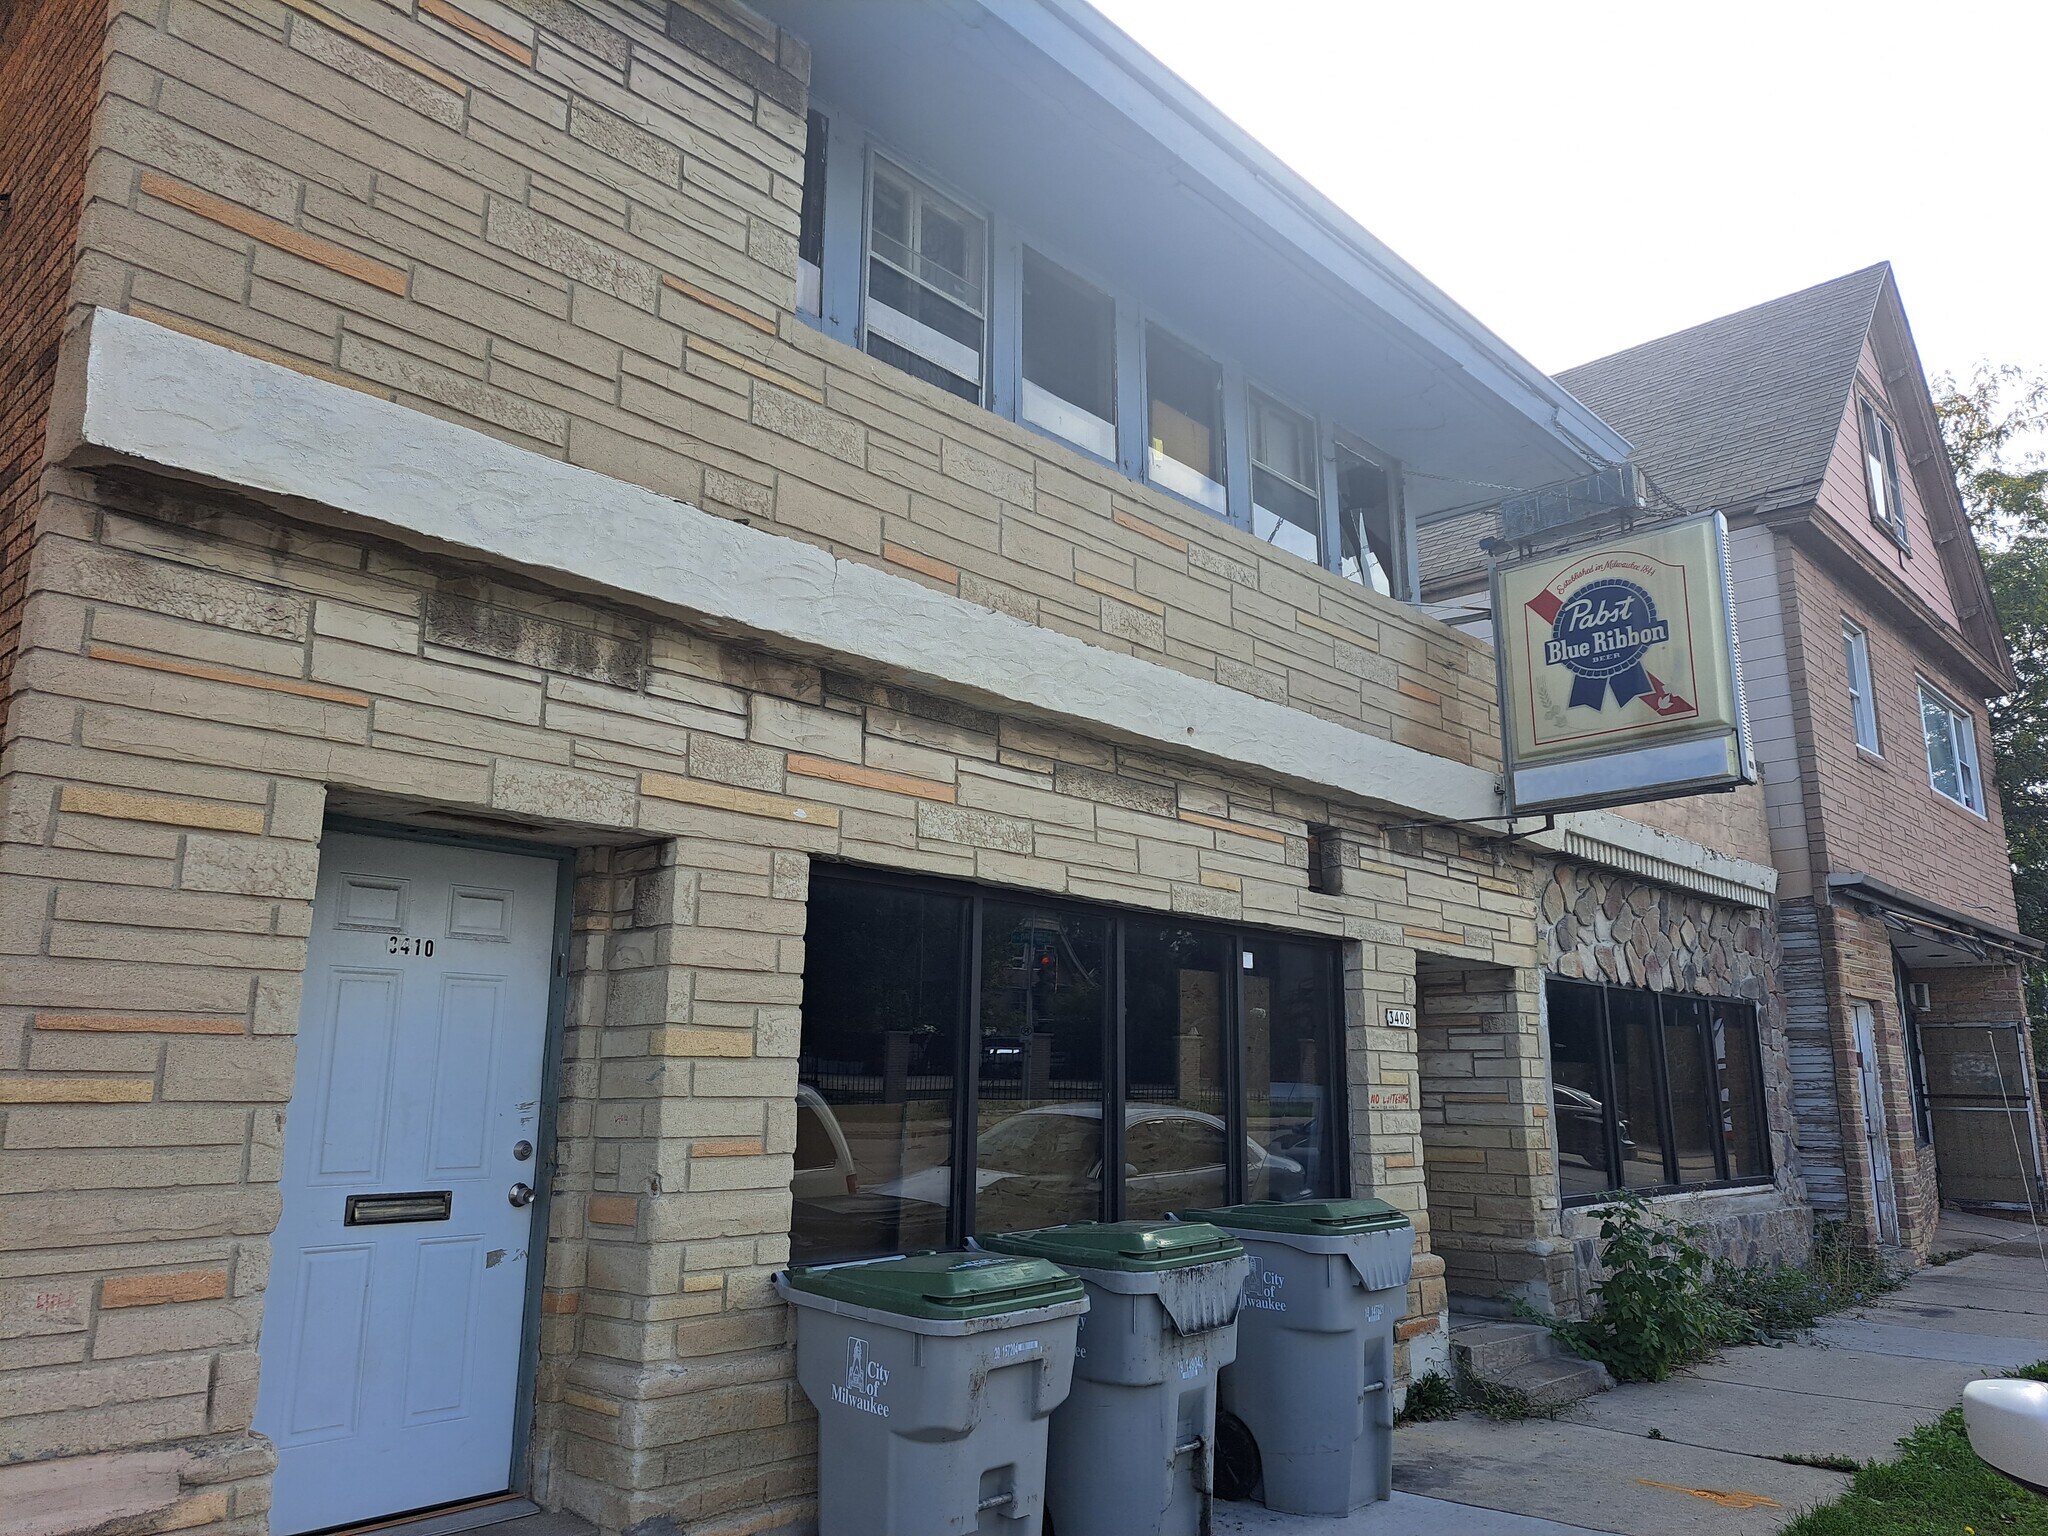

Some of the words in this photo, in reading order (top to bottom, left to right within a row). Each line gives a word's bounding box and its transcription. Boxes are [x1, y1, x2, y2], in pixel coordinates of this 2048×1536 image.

[1602, 560, 1641, 571] Milwaukee
[1640, 565, 1656, 577] 1844
[1565, 596, 1635, 632] Pabst
[1547, 640, 1590, 663] Blue
[1592, 625, 1666, 654] Ribbon
[1592, 652, 1621, 663] BEER
[389, 935, 434, 957] 3410
[1389, 1010, 1410, 1025] 3408
[1370, 1094, 1380, 1104] NO
[1263, 1271, 1285, 1289] City
[1263, 1285, 1276, 1298] of
[868, 1361, 890, 1386] City
[866, 1380, 880, 1397] of
[831, 1383, 890, 1418] Milwaukee
